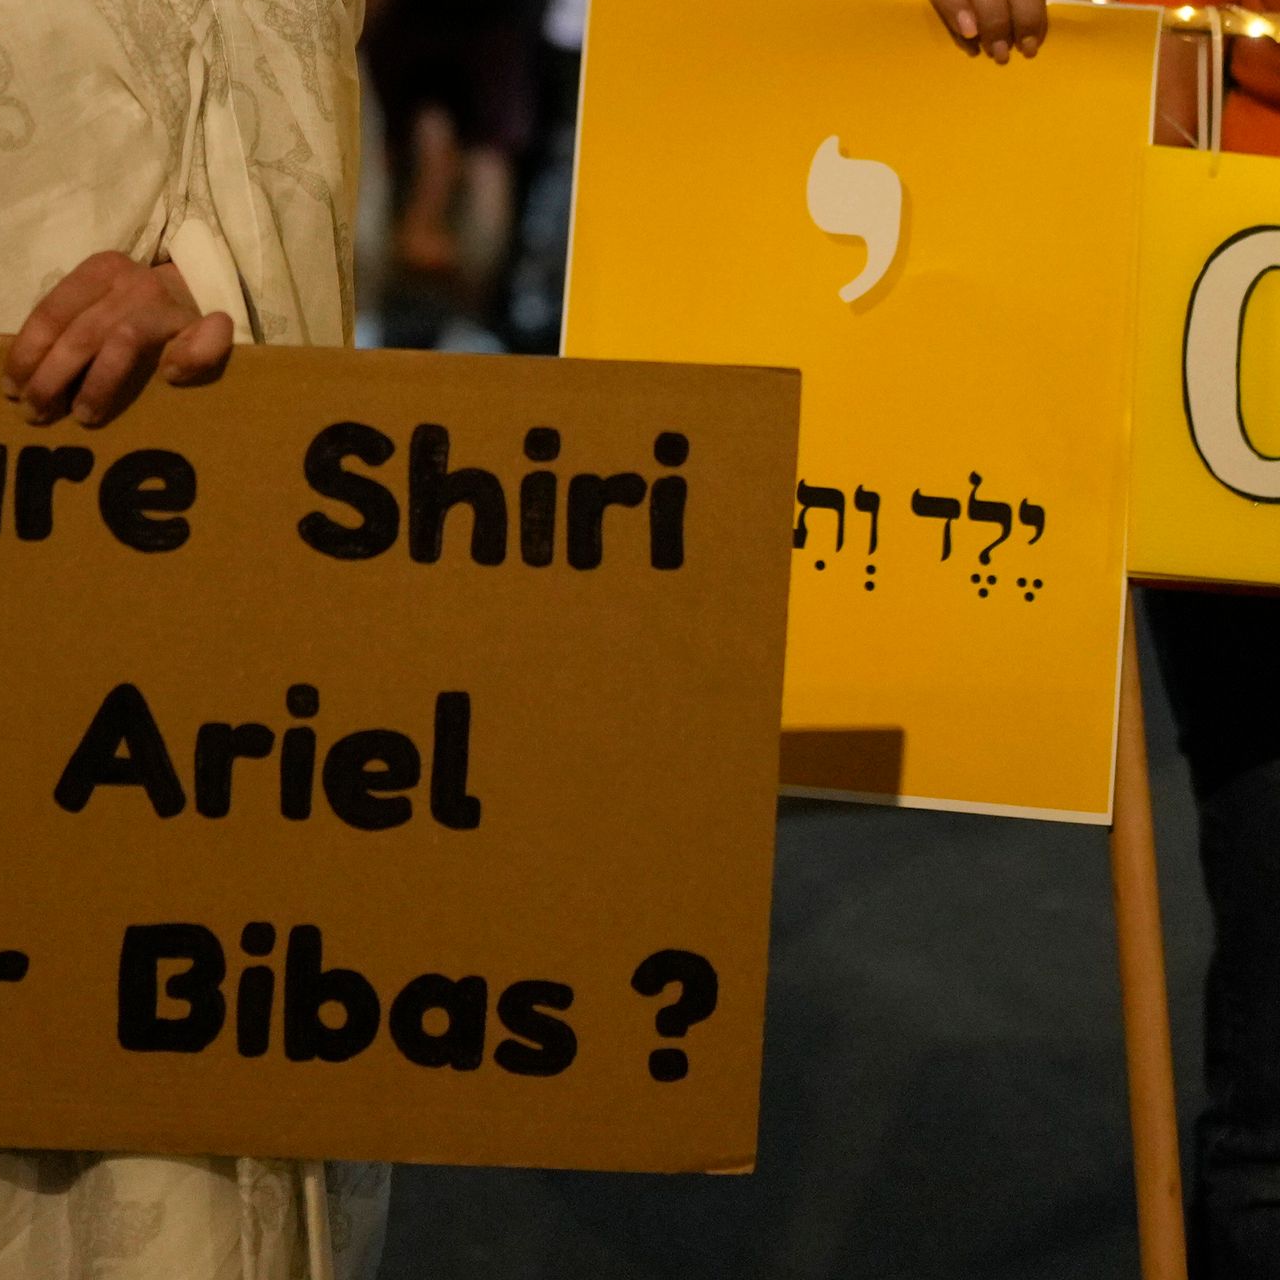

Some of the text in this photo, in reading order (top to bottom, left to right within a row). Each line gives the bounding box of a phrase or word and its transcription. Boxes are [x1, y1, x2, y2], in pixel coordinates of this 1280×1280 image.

[806, 134, 902, 304] י
[298, 421, 690, 571] Shiri
[53, 682, 482, 832] Ariel
[117, 921, 579, 1078] Bibas
